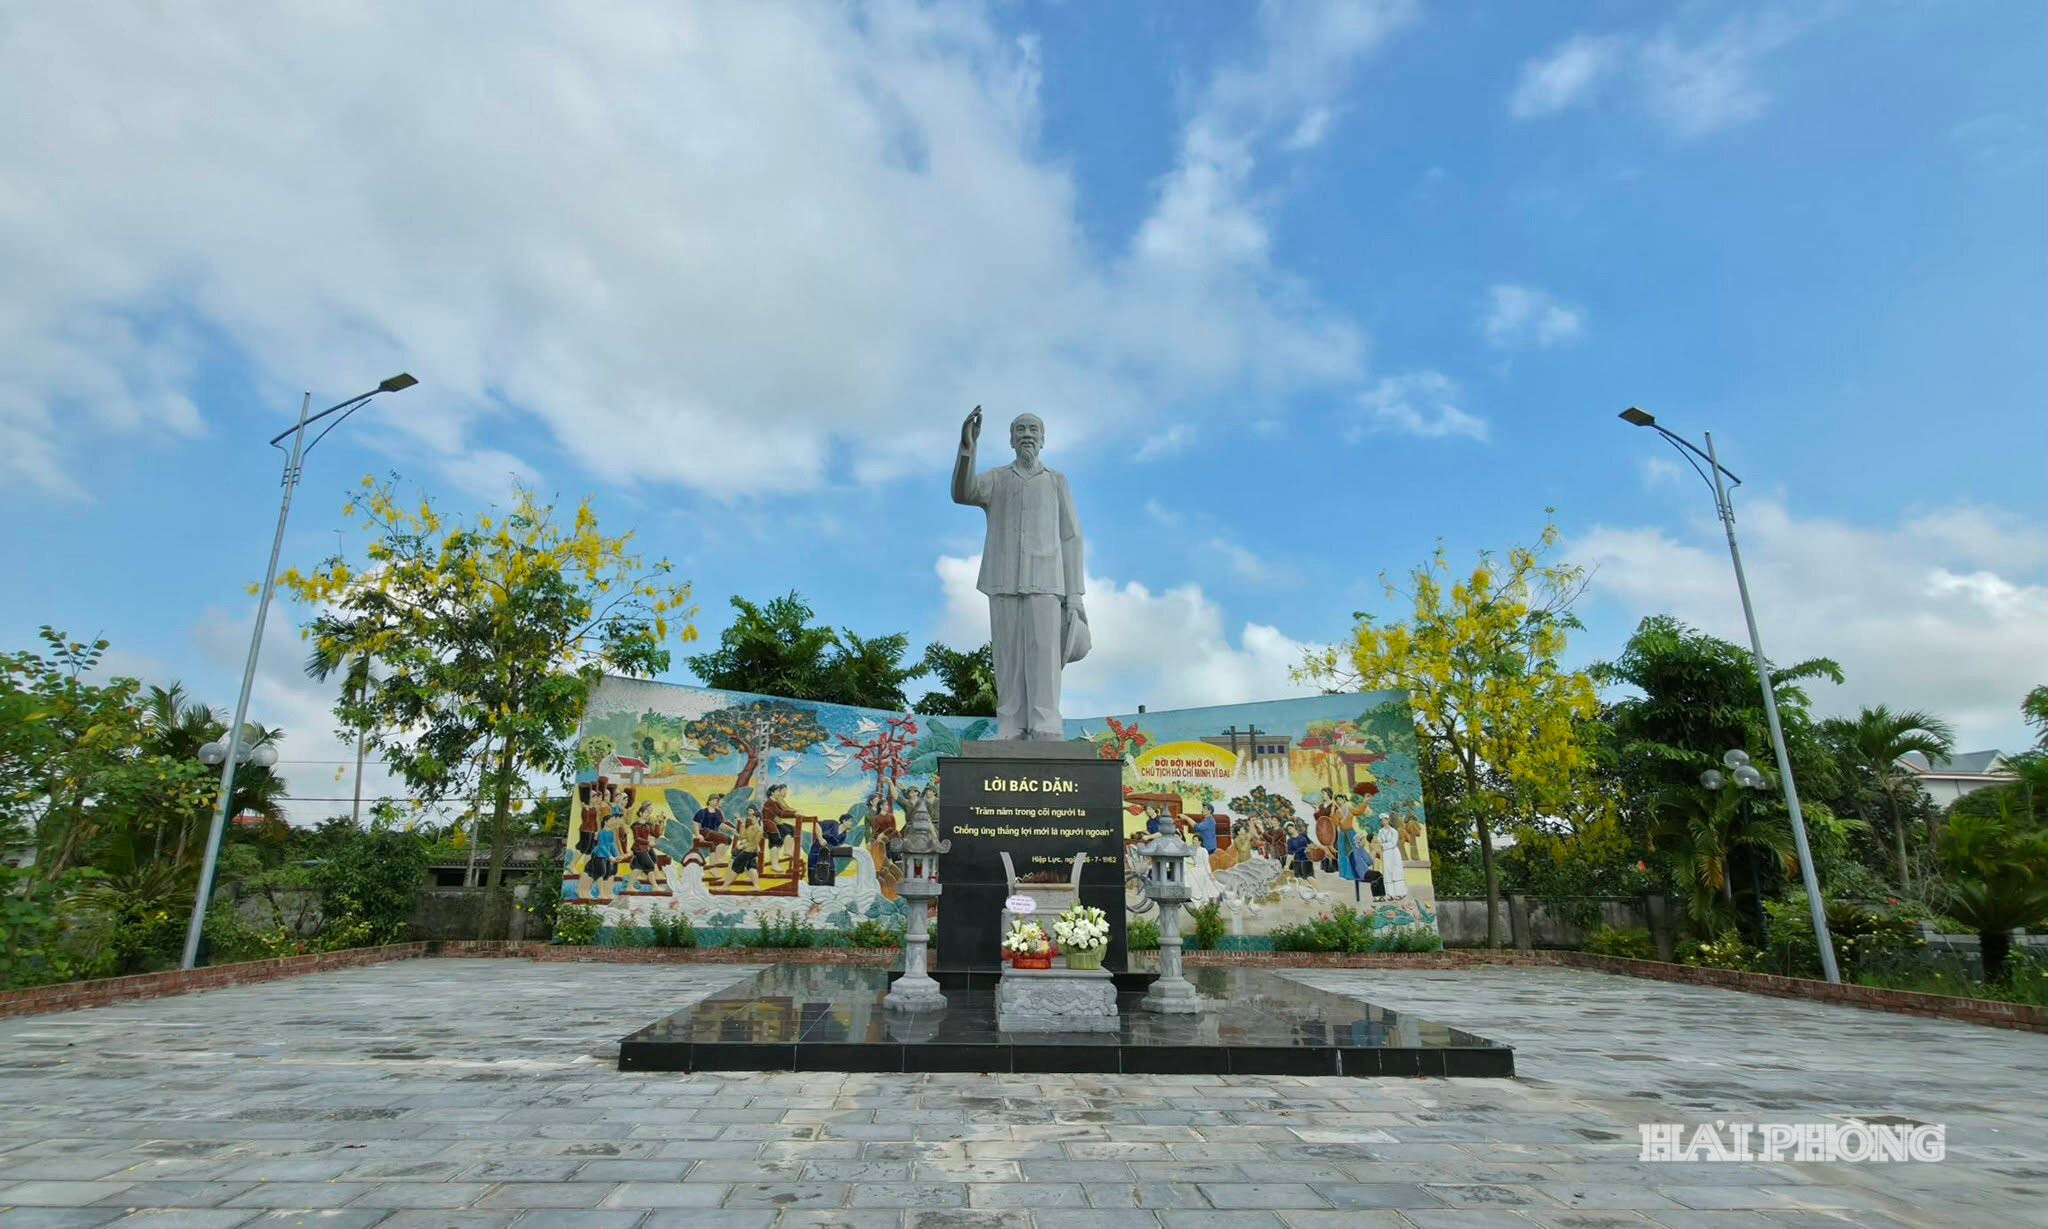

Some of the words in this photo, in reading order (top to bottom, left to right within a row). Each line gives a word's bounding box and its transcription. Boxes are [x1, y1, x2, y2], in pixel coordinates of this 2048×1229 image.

[1194, 768, 1210, 777] MINH
[984, 776, 1006, 792] LỜI
[1010, 777, 1038, 792] BÁC
[1042, 778, 1078, 796] DẶN:
[996, 807, 1014, 816] năm
[1015, 808, 1036, 818] trong
[1038, 808, 1050, 816] cõi
[1052, 808, 1076, 818] người
[980, 826, 996, 836] úng
[997, 824, 1020, 836] thắng
[1021, 827, 1032, 836] lợi
[1034, 827, 1050, 836] mới
[1051, 827, 1058, 836] là
[1060, 827, 1084, 837] người
